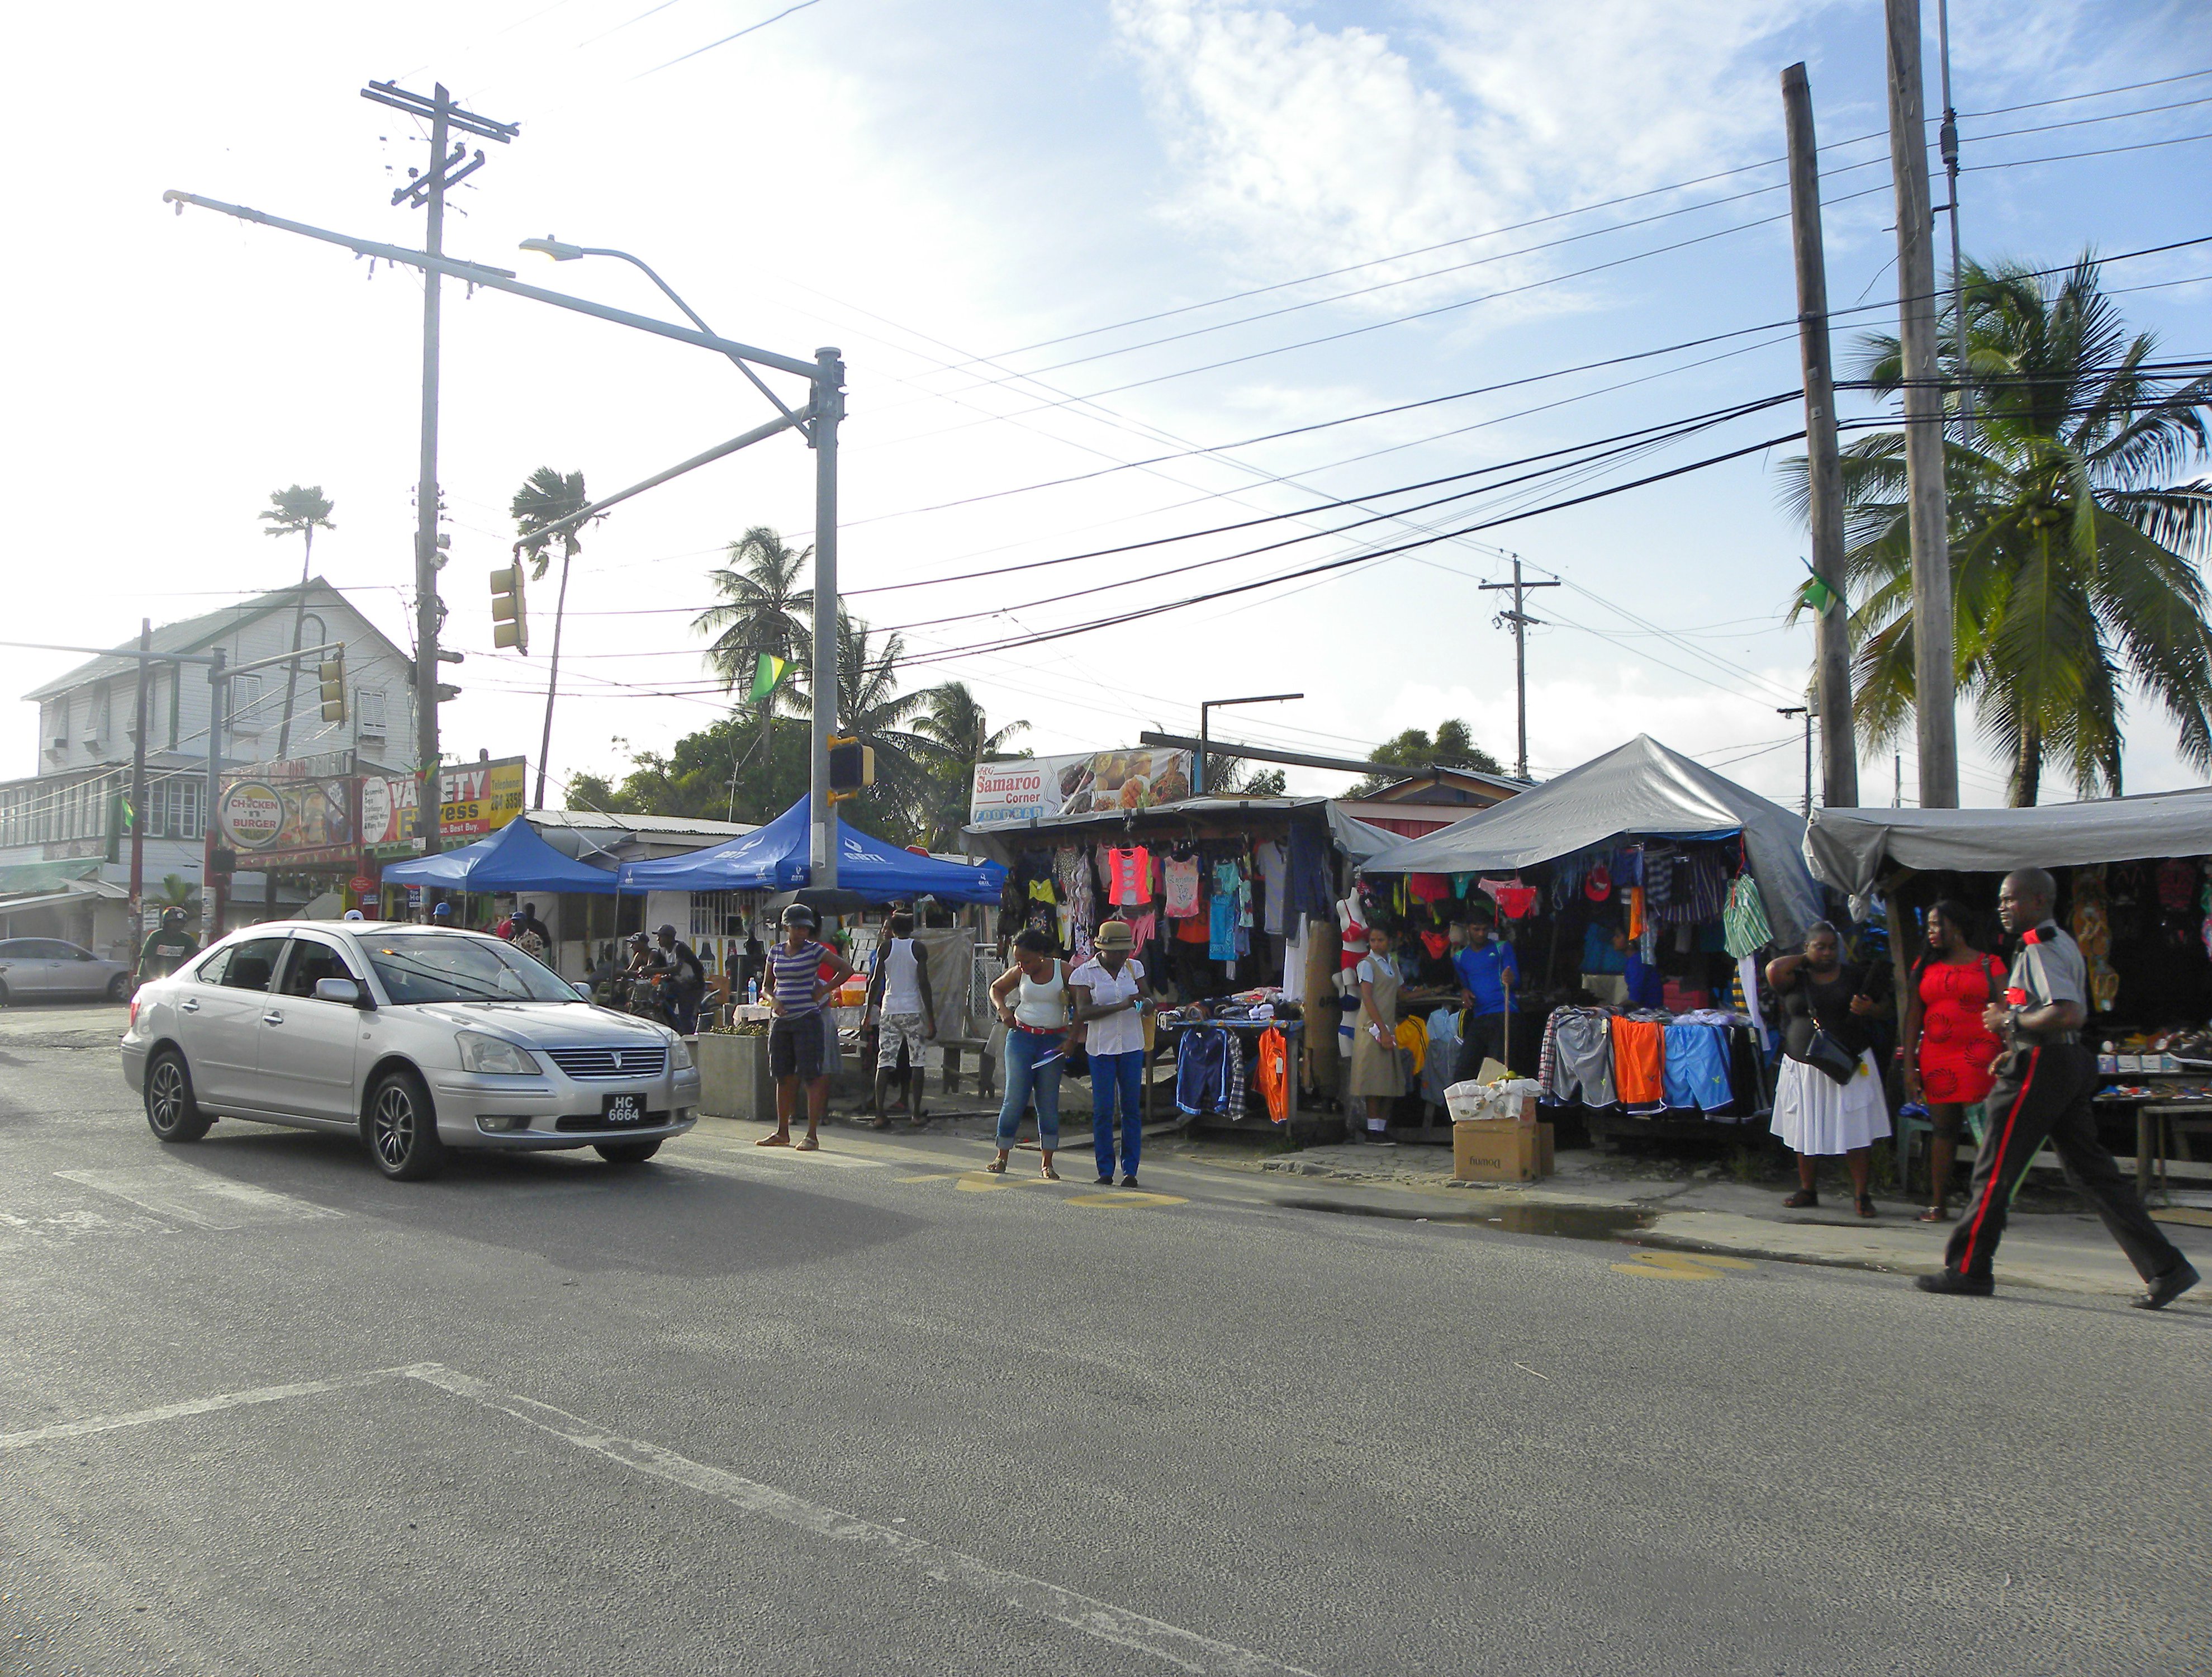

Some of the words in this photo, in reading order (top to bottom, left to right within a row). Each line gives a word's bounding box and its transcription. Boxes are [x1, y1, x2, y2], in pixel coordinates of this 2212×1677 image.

[976, 766, 995, 775] A&G
[392, 771, 485, 808] VAETY
[976, 776, 1041, 793] Samaroo
[1006, 793, 1040, 803] Corner
[231, 799, 278, 809] CHICKEN
[975, 809, 1011, 823] FOOD
[1013, 806, 1043, 819] BAR
[233, 818, 276, 828] BURGER
[450, 823, 463, 832] Best
[466, 822, 479, 832] Buy.
[844, 852, 886, 862] GBTI
[615, 1097, 633, 1108] HC
[609, 1108, 639, 1120] 6664
[1470, 1156, 1501, 1168] Downy
